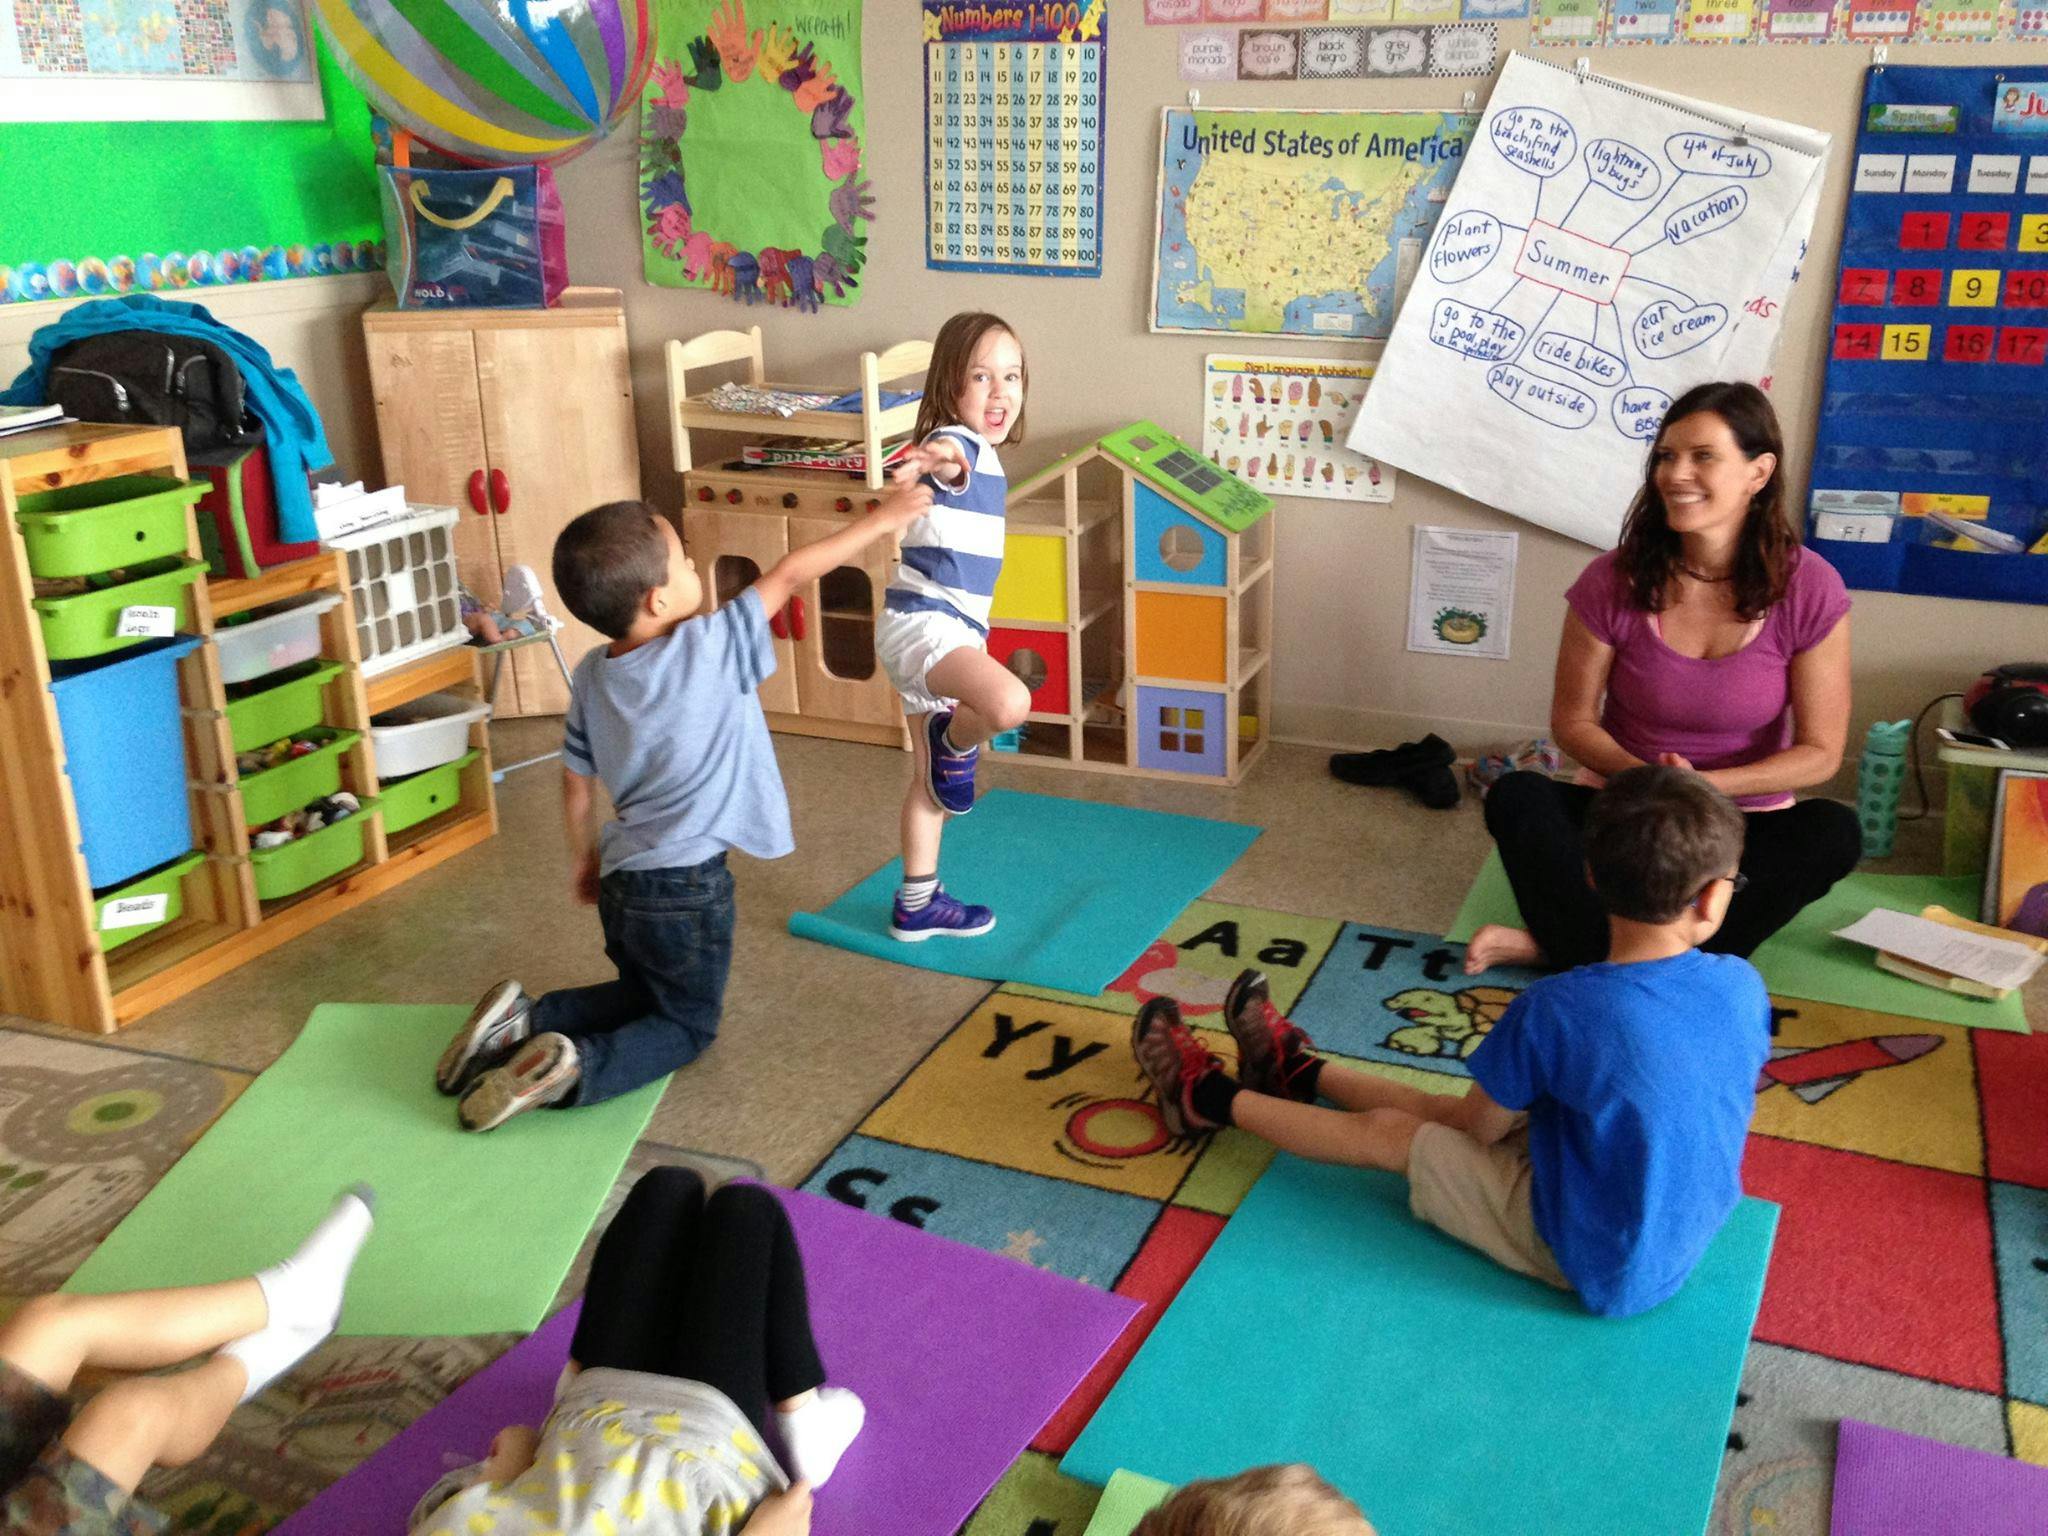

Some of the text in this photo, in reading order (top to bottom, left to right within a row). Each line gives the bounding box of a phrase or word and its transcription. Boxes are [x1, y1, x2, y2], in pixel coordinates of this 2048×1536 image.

[1558, 3, 1580, 12] one
[1635, 0, 1656, 9] two
[795, 10, 850, 40] Wreath!
[942, 3, 1081, 33] Numbers 1-100
[950, 48, 956, 60] 2
[966, 48, 973, 60] 3
[982, 48, 989, 60] 4
[1000, 48, 1005, 60] 5
[1015, 48, 1022, 60] 6
[1033, 48, 1039, 60] 7
[1050, 48, 1057, 60] 8
[1067, 48, 1075, 60] 9
[1084, 48, 1095, 60] 10
[1192, 44, 1223, 55] purple
[1252, 42, 1286, 52] brown
[1319, 40, 1345, 51] black
[1384, 40, 1410, 54] grey
[1188, 55, 1226, 65] morado
[1315, 53, 1347, 67] negro
[934, 70, 1097, 83] 11 12 13 14 15 16 17 18 19 20
[934, 92, 1096, 106] 21 22 23 24 25 26 27 28 29 30
[1507, 110, 1523, 131] go
[1549, 122, 1569, 138] the
[933, 137, 1095, 151] 41 42 43 44 45 46 47 48 49 50
[1183, 123, 1463, 163] United States of America
[1505, 144, 1556, 170] seashells
[1592, 139, 1648, 178] lightning
[1683, 138, 1758, 177] 4th of July
[1607, 162, 1640, 191] bugs
[1864, 168, 1897, 179] Sunday
[1912, 168, 1949, 180] Monday
[1977, 168, 2012, 179] Tuesday
[1443, 219, 1493, 246] plant
[1922, 220, 2048, 244] 1 2 3
[934, 243, 1095, 261] 91 92 93 94 95 96 97 98 99 100
[1434, 244, 1491, 269] flowers
[1526, 238, 1610, 287] Summer
[1857, 276, 2046, 299] 7 8 9 10
[1440, 305, 1517, 341] go to the
[1641, 306, 1668, 331] eat
[1642, 313, 1717, 350] ice cream
[1844, 331, 2039, 354] 14 15 16 17
[1477, 337, 1508, 356] play
[1538, 338, 1617, 378] ride bikes
[1244, 362, 1362, 379] Sign Language Alphabet
[1491, 369, 1586, 414] play outside
[1621, 393, 1668, 415] have a
[773, 452, 812, 465] Pizza
[1177, 920, 1308, 967] A a
[1356, 932, 1462, 982] T t
[980, 1013, 1110, 1080] Y y
